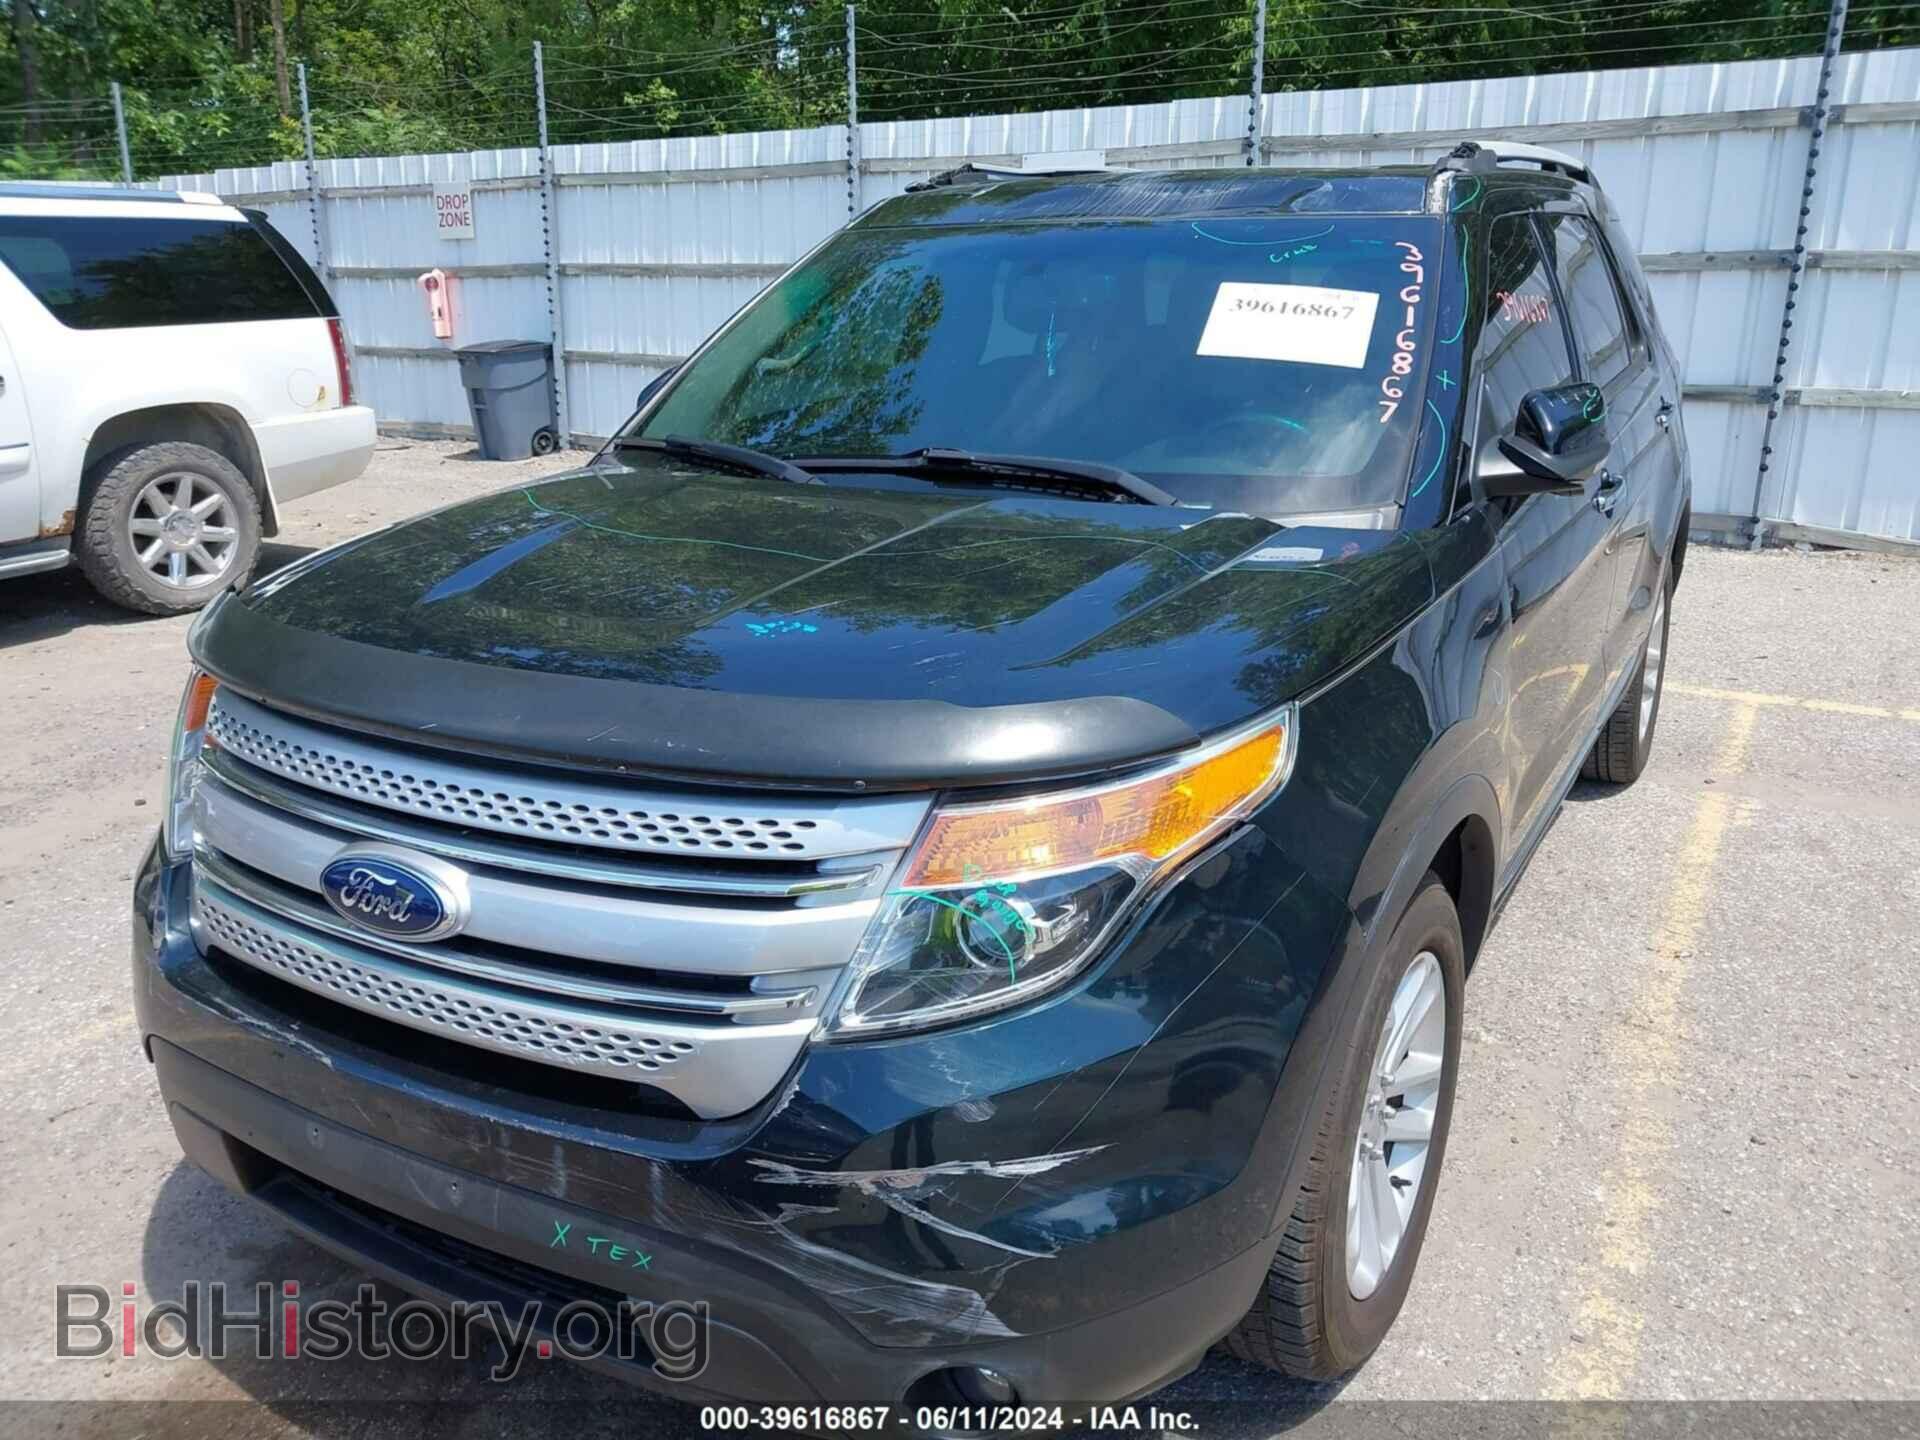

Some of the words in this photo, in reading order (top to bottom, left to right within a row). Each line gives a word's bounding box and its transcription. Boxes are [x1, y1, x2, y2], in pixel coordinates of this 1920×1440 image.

[437, 194, 468, 210] DROP
[439, 212, 470, 227] ZONE
[1228, 297, 1355, 320] 39616867
[1379, 241, 1424, 423] 39616867
[340, 867, 414, 923] Ford
[550, 1220, 571, 1248] X
[586, 1236, 652, 1270] TEX
